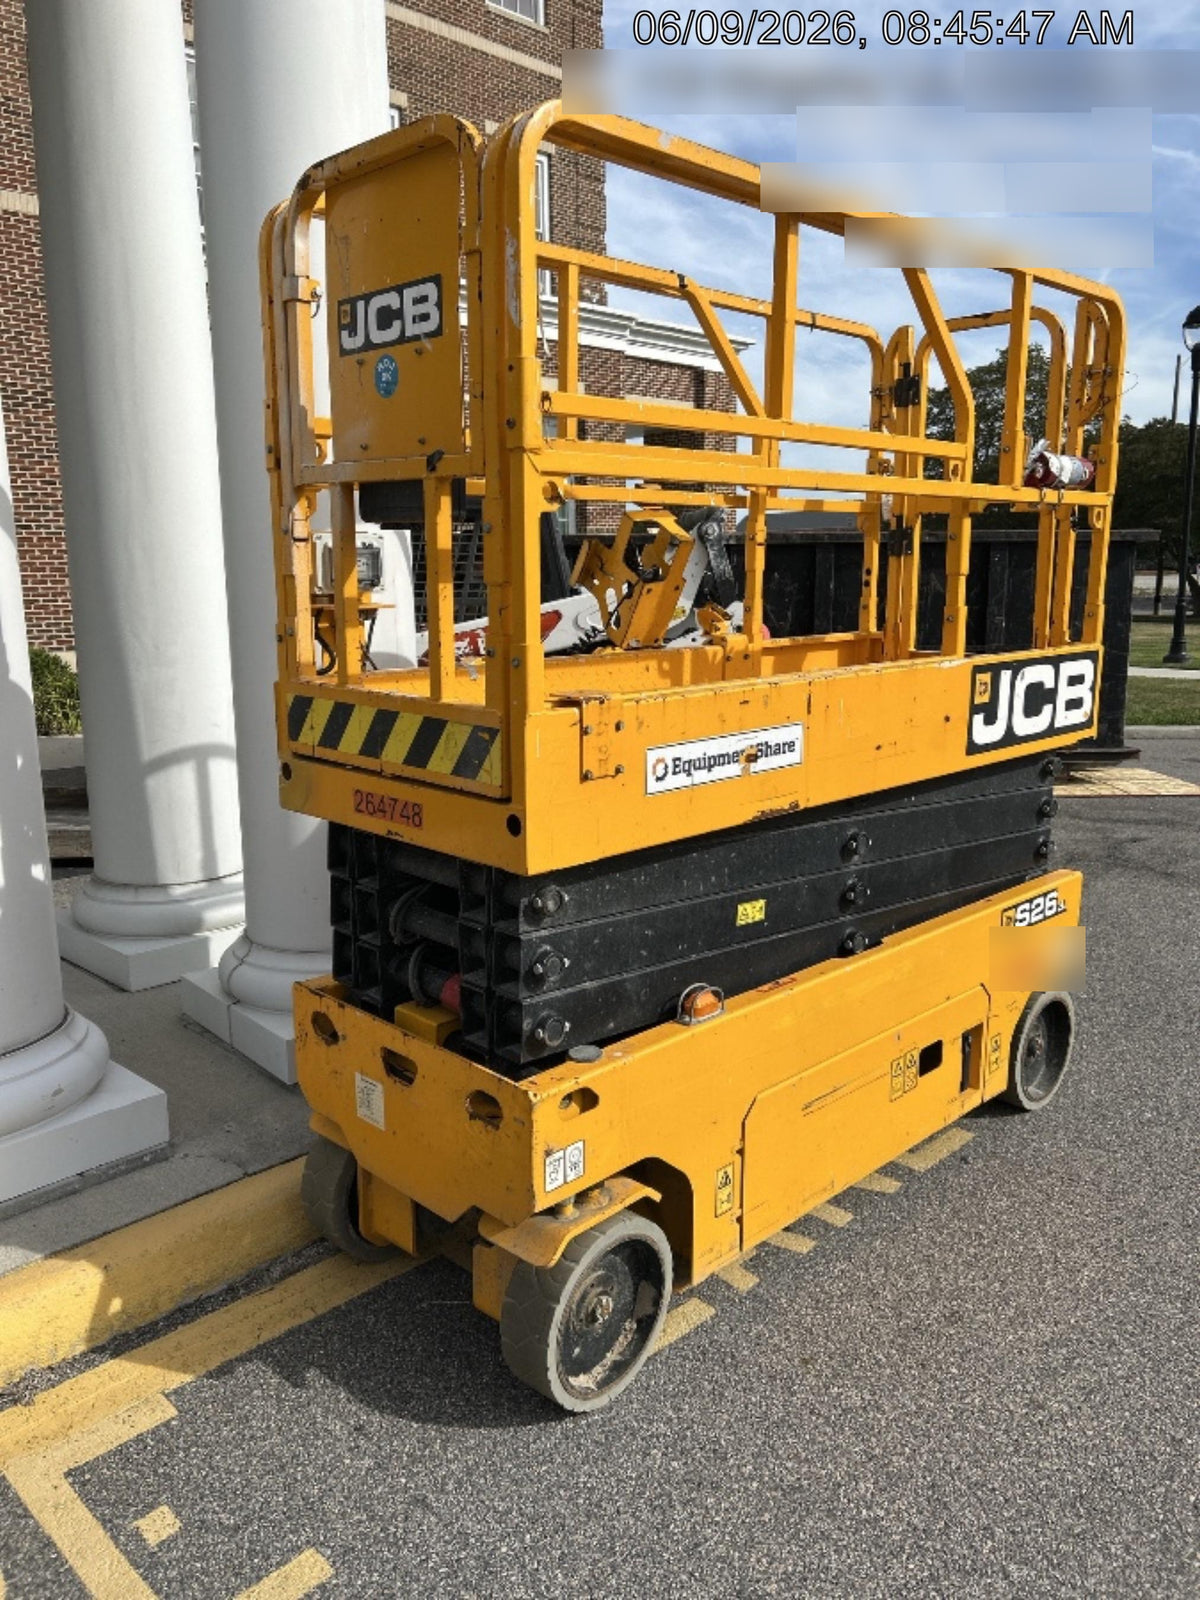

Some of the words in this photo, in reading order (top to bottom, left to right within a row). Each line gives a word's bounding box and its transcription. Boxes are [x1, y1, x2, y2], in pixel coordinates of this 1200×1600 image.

[341, 282, 440, 350] JCB
[972, 659, 1095, 745] JCB
[671, 740, 796, 777] EquipmeShare
[354, 789, 422, 828] 264748
